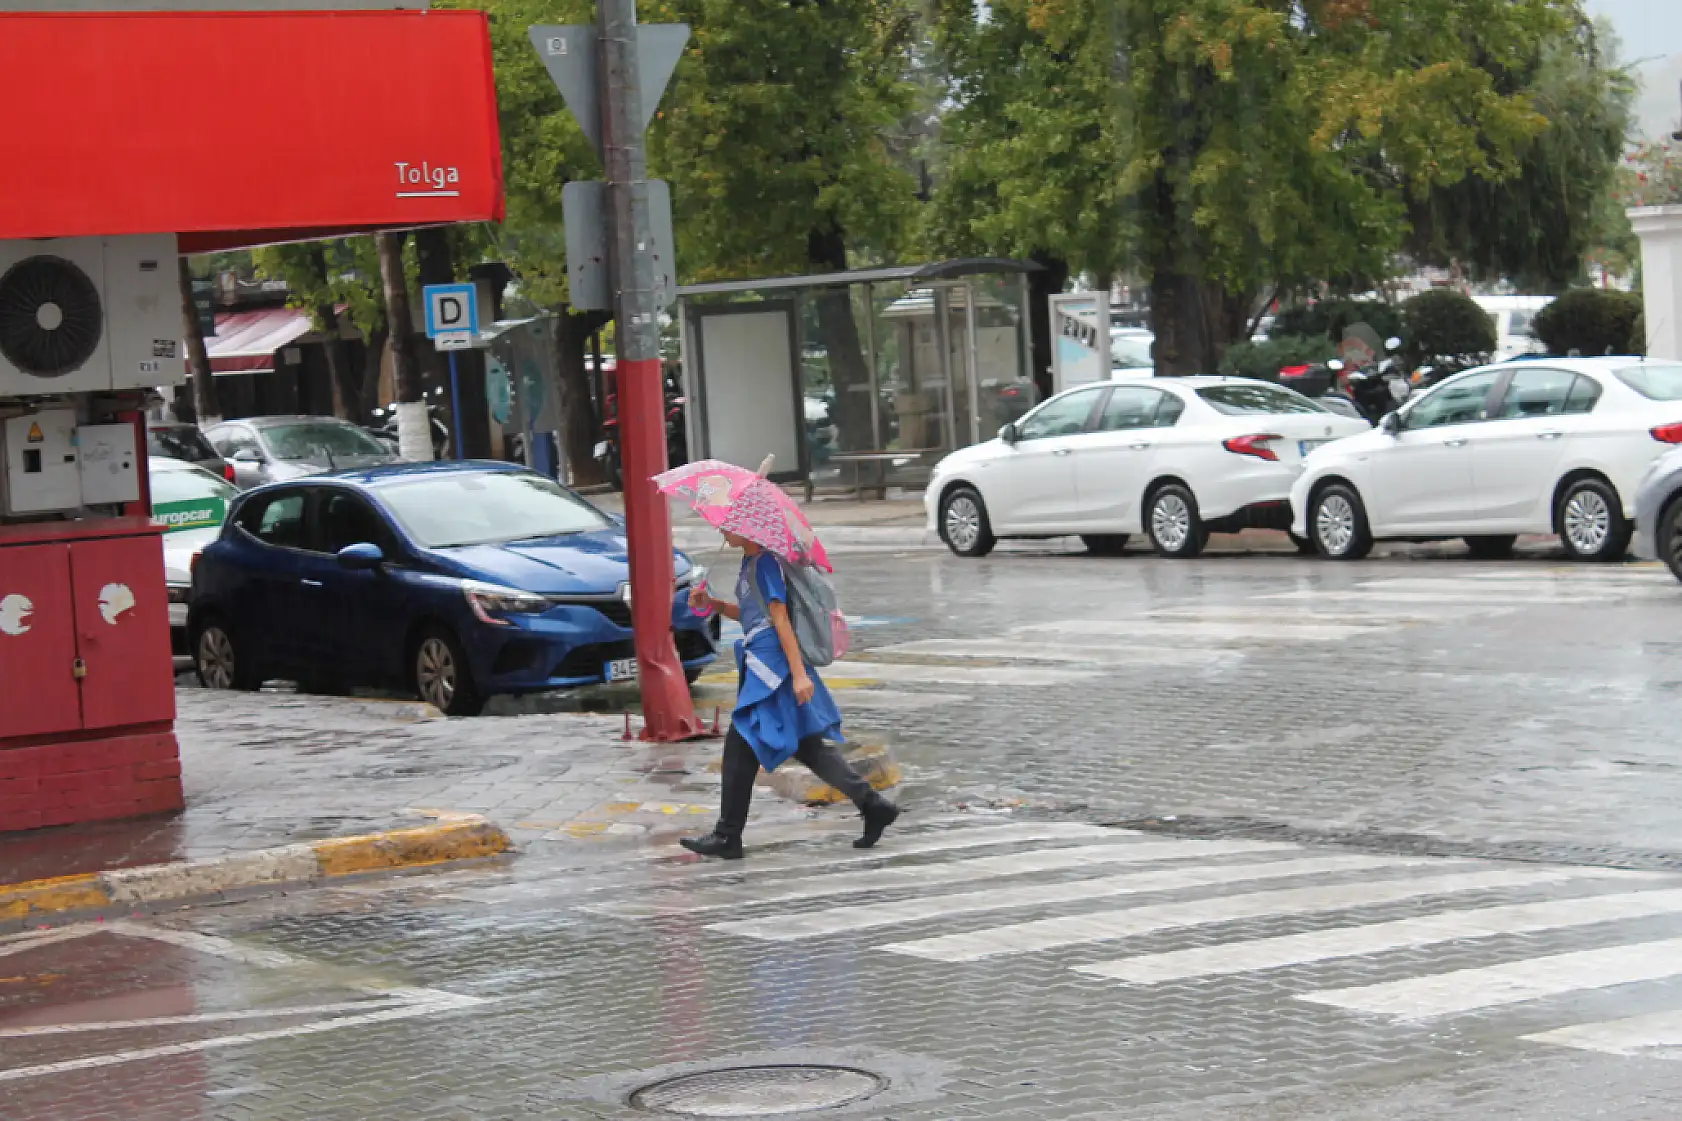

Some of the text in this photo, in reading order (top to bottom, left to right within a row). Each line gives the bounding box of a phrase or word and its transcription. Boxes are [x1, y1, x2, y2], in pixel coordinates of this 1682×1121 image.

[394, 161, 459, 189] Tolga
[440, 297, 461, 325] D
[153, 508, 213, 527] uropcar
[612, 661, 629, 677] 34
